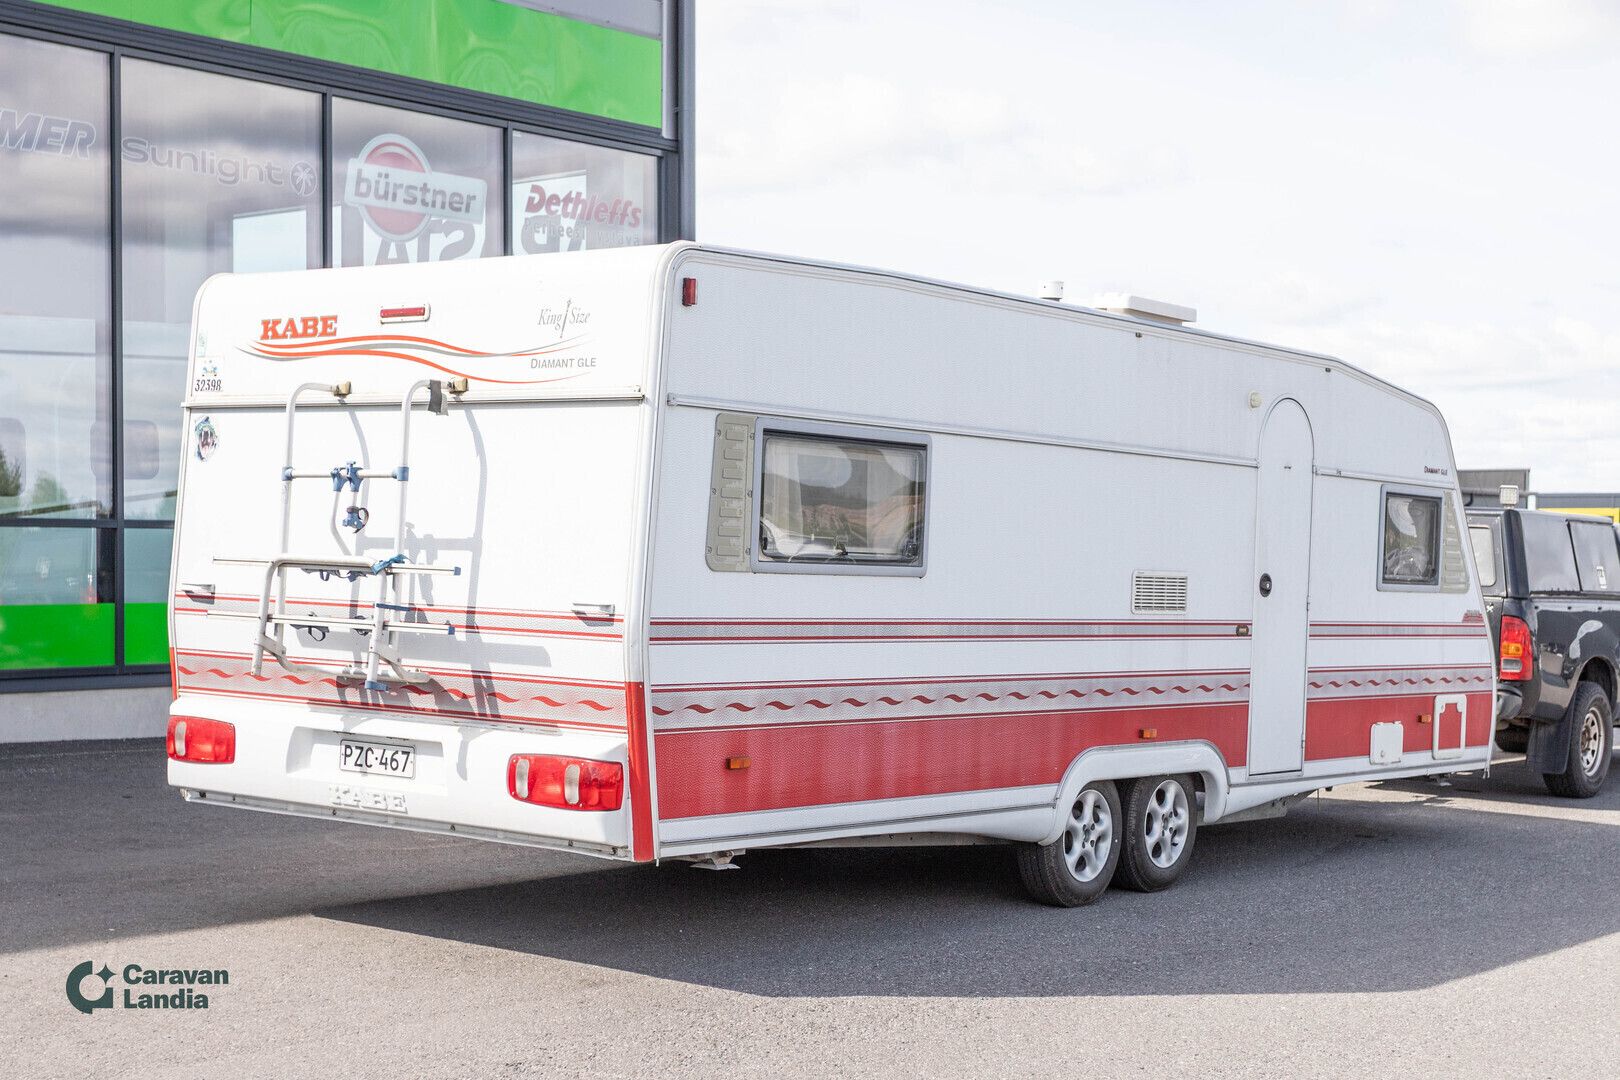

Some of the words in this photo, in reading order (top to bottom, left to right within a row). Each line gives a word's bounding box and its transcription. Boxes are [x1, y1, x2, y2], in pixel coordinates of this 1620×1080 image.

[121, 136, 284, 188] Sunlight
[353, 168, 477, 214] bürstner
[525, 184, 642, 228] Dethleffs
[260, 314, 339, 341] KABE
[537, 308, 562, 331] King
[569, 307, 591, 325] Size
[577, 357, 597, 368] GLE
[194, 378, 222, 393] 32398
[329, 786, 408, 813] KABE
